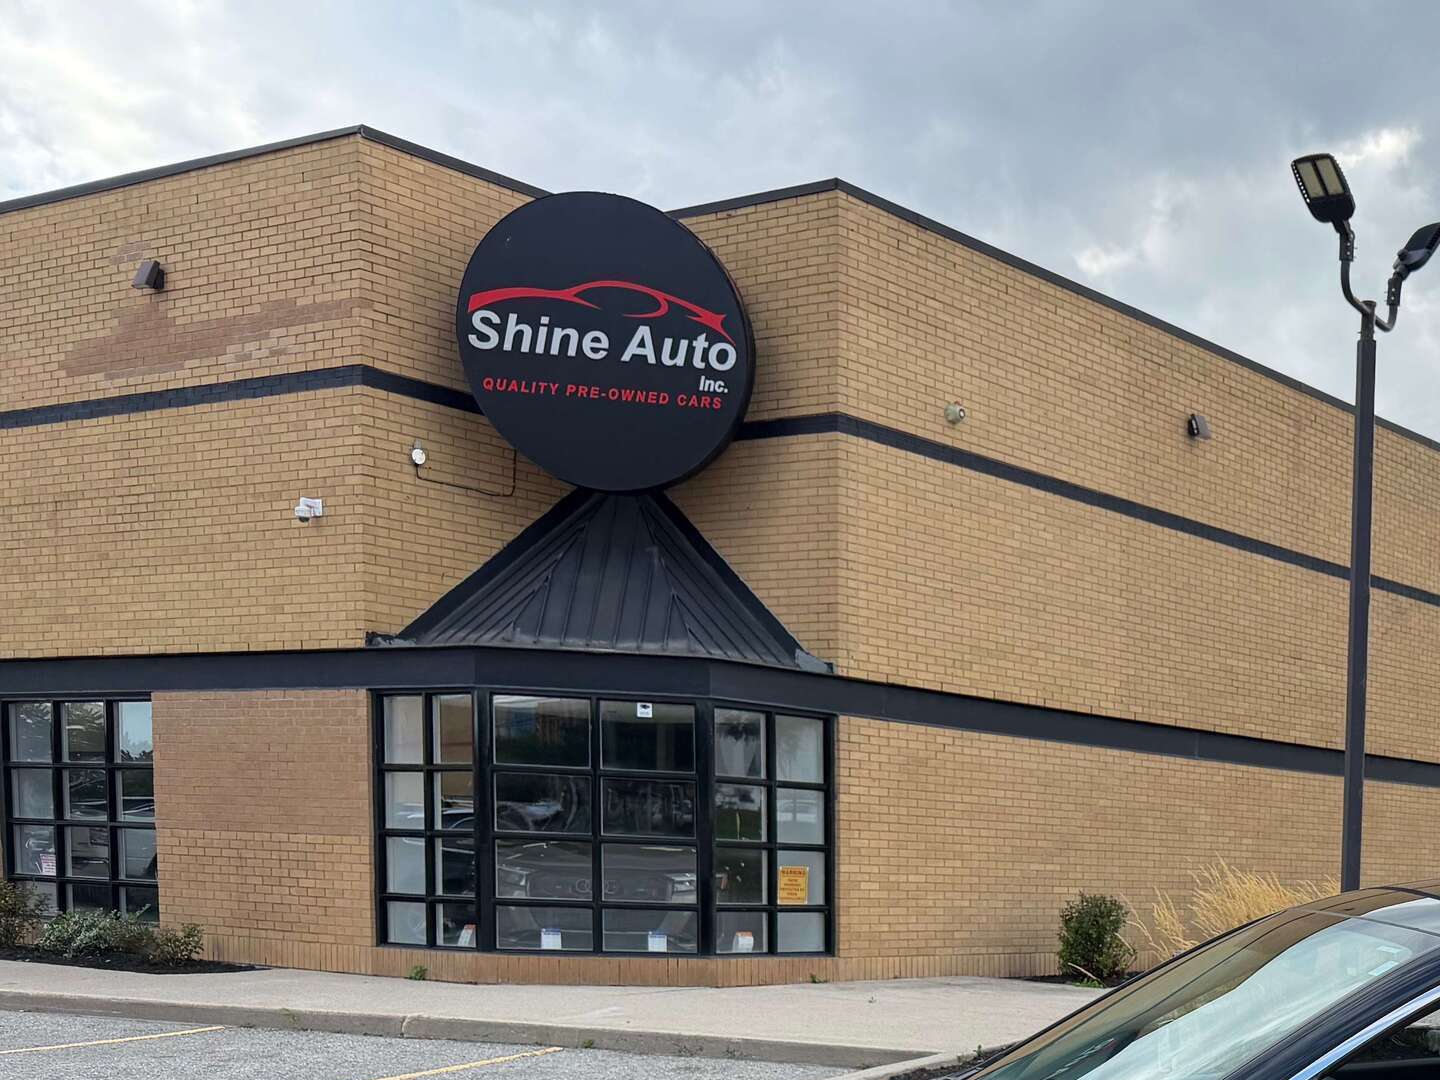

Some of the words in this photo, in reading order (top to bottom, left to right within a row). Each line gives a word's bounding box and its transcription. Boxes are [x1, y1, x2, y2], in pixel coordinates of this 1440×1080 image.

[468, 310, 610, 360] Shine
[621, 325, 737, 371] Auto
[483, 377, 559, 396] QUALITY
[565, 385, 669, 405] PRE-OWNED
[676, 392, 722, 409] CARS
[699, 375, 729, 394] Inc.
